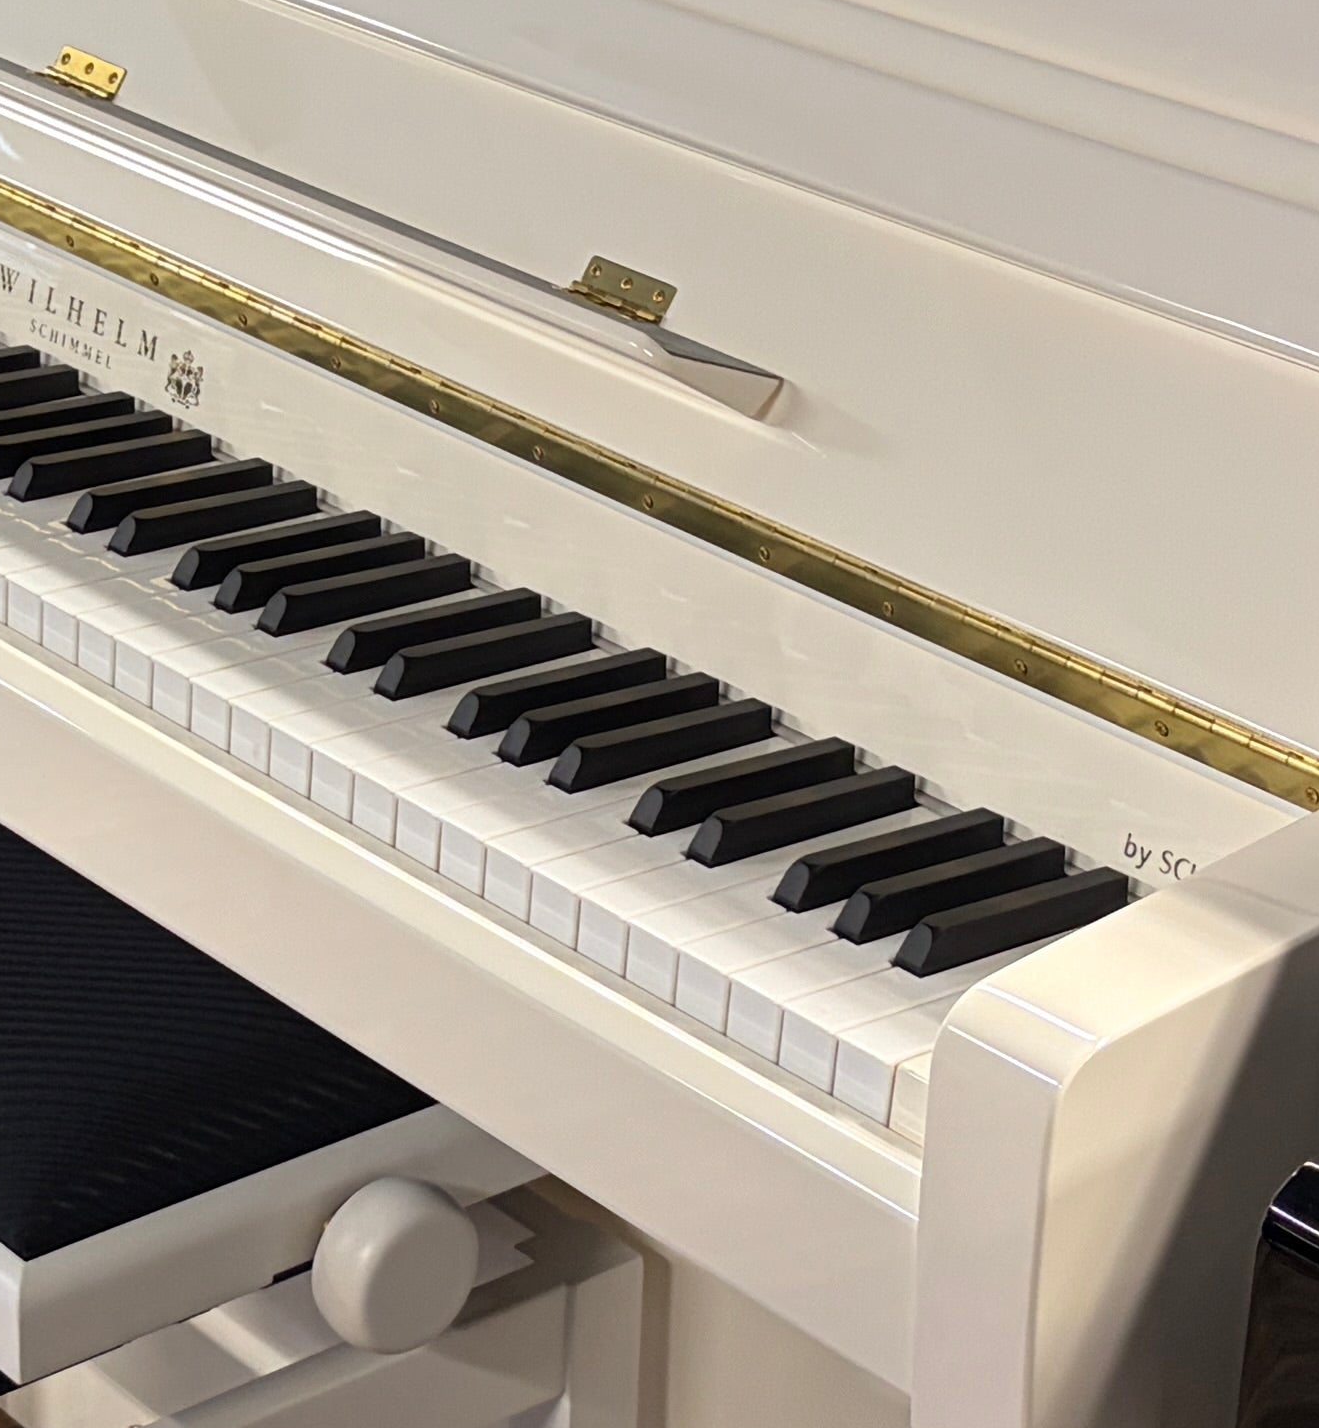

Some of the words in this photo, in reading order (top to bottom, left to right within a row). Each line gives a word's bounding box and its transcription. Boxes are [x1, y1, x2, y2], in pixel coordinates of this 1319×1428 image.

[0, 263, 159, 362] WILHELM
[30, 318, 113, 370] SCHIMMEL
[1124, 832, 1153, 870] by
